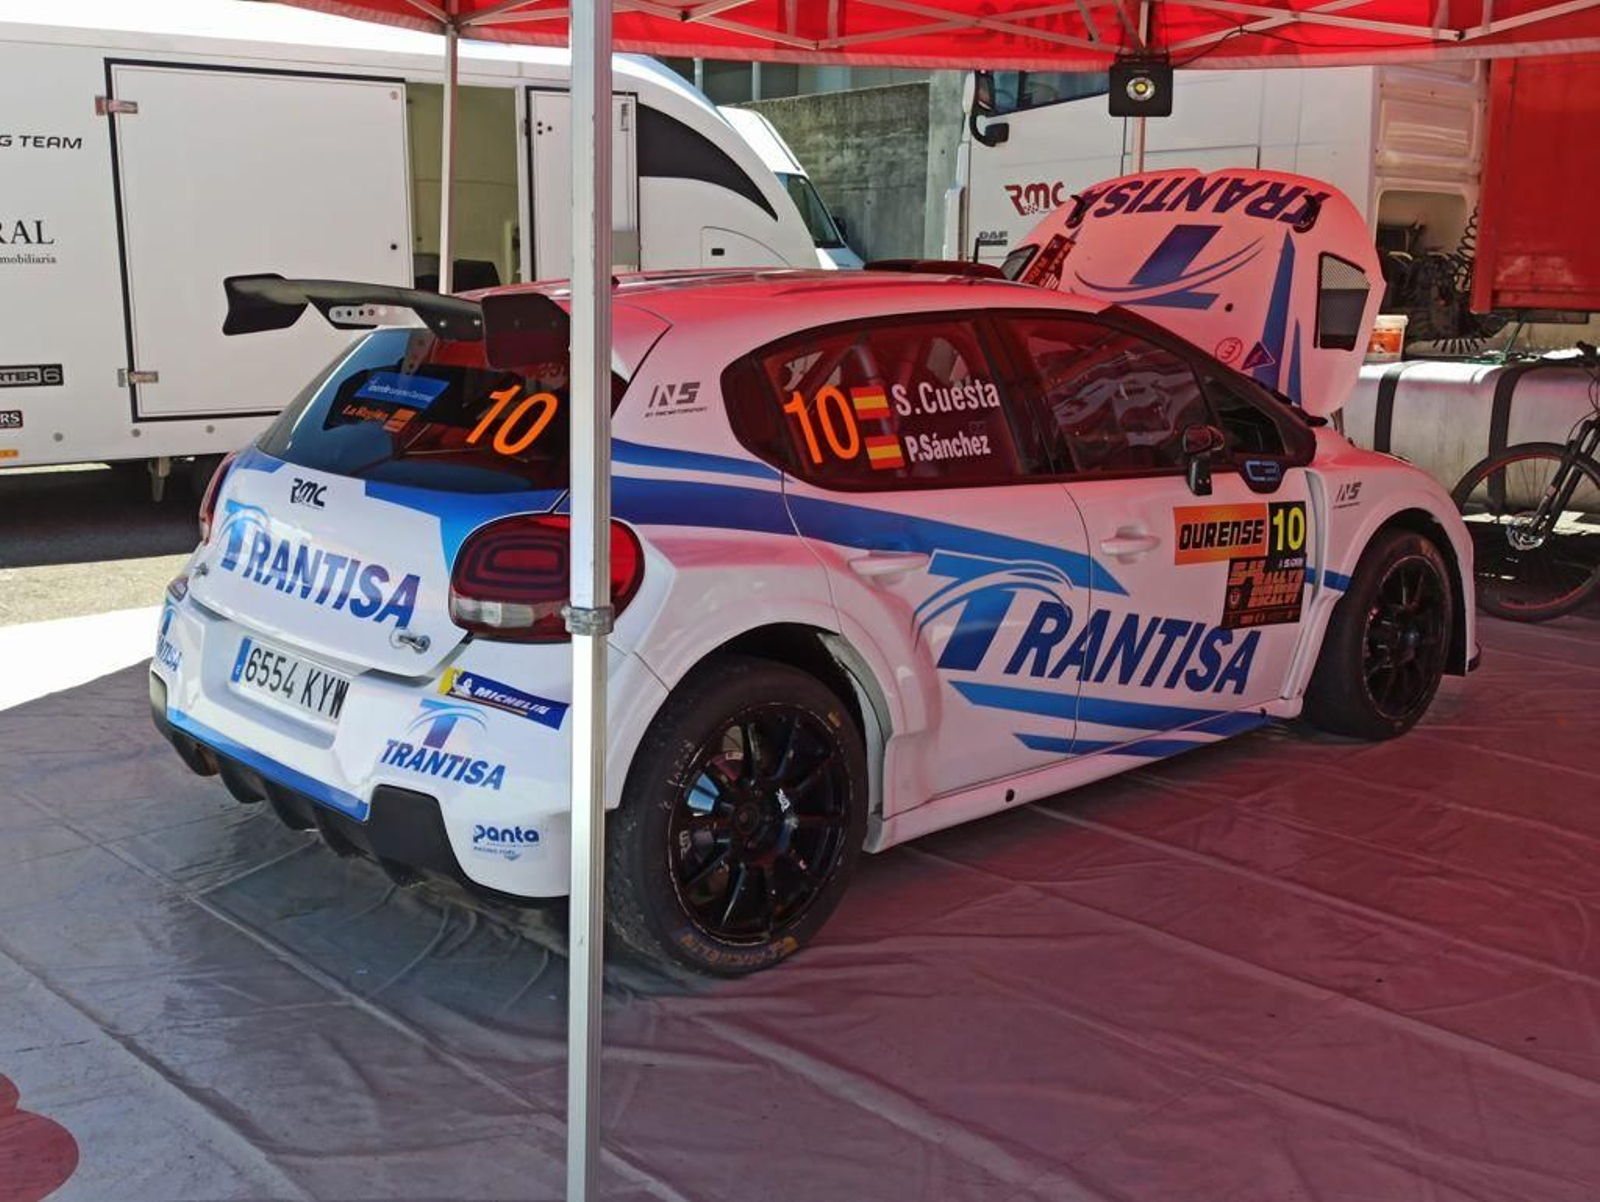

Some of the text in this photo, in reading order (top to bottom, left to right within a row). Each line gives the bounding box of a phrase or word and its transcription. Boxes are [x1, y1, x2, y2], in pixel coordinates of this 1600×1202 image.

[19, 135, 82, 149] TEAM
[466, 384, 558, 456] 10
[784, 379, 1001, 464] 10 S.Cuesta
[904, 430, 991, 463] P.Sánchez
[1178, 506, 1306, 551] OURENSE 10
[218, 499, 421, 628] TRANTISA
[913, 548, 1262, 695] TRANTISA
[245, 648, 350, 719] 6554 KYW
[474, 686, 550, 715] MICHELIN
[380, 738, 506, 790] TRANTISA
[472, 824, 540, 843] panta
